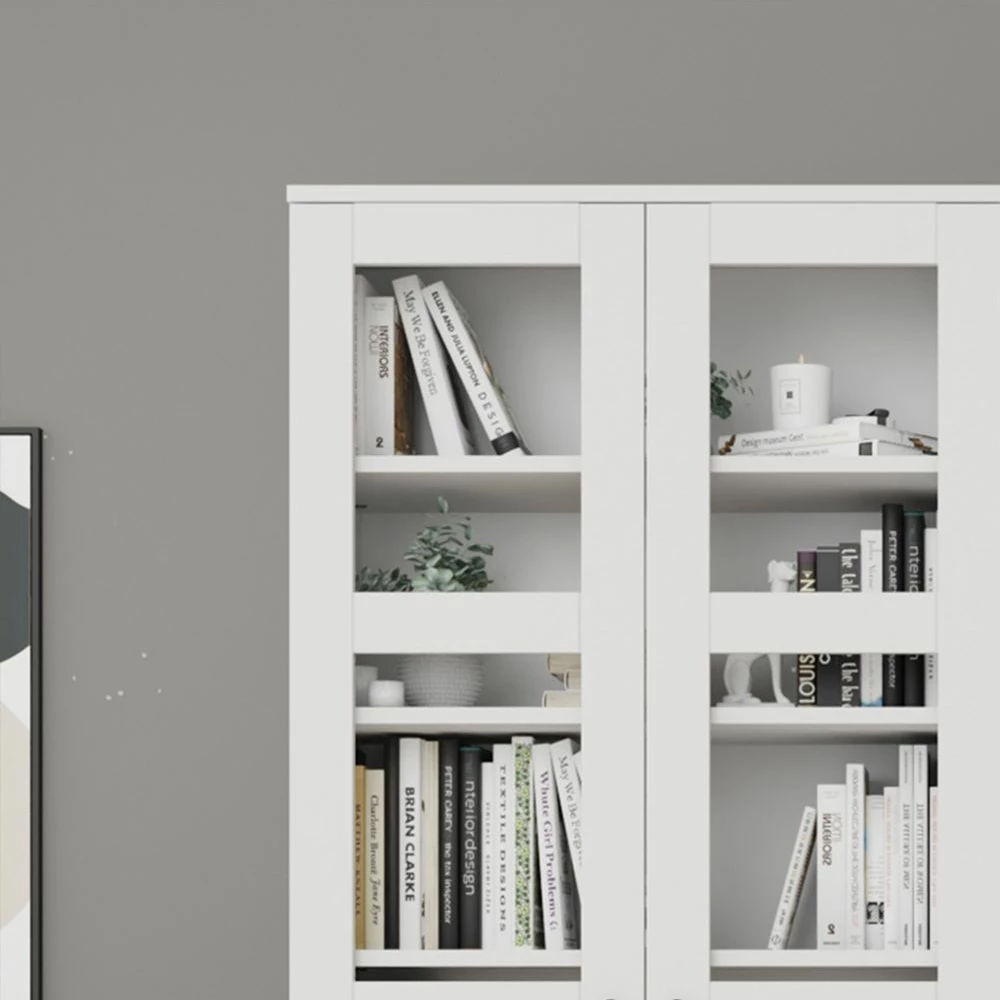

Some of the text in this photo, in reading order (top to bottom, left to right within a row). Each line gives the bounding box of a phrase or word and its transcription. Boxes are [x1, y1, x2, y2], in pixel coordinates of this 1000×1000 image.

[411, 315, 422, 332] We
[415, 332, 427, 348] Be
[431, 291, 446, 315] ELLEN
[443, 314, 454, 332] AND
[461, 355, 480, 387] LUPTON
[379, 325, 388, 378] INTERIORS
[419, 350, 438, 396] Forgiven
[376, 437, 383, 447] 2
[563, 784, 574, 802] We
[405, 787, 415, 901] BRIAN CLARKE
[541, 820, 553, 850] Girl
[546, 853, 556, 918] Problems
